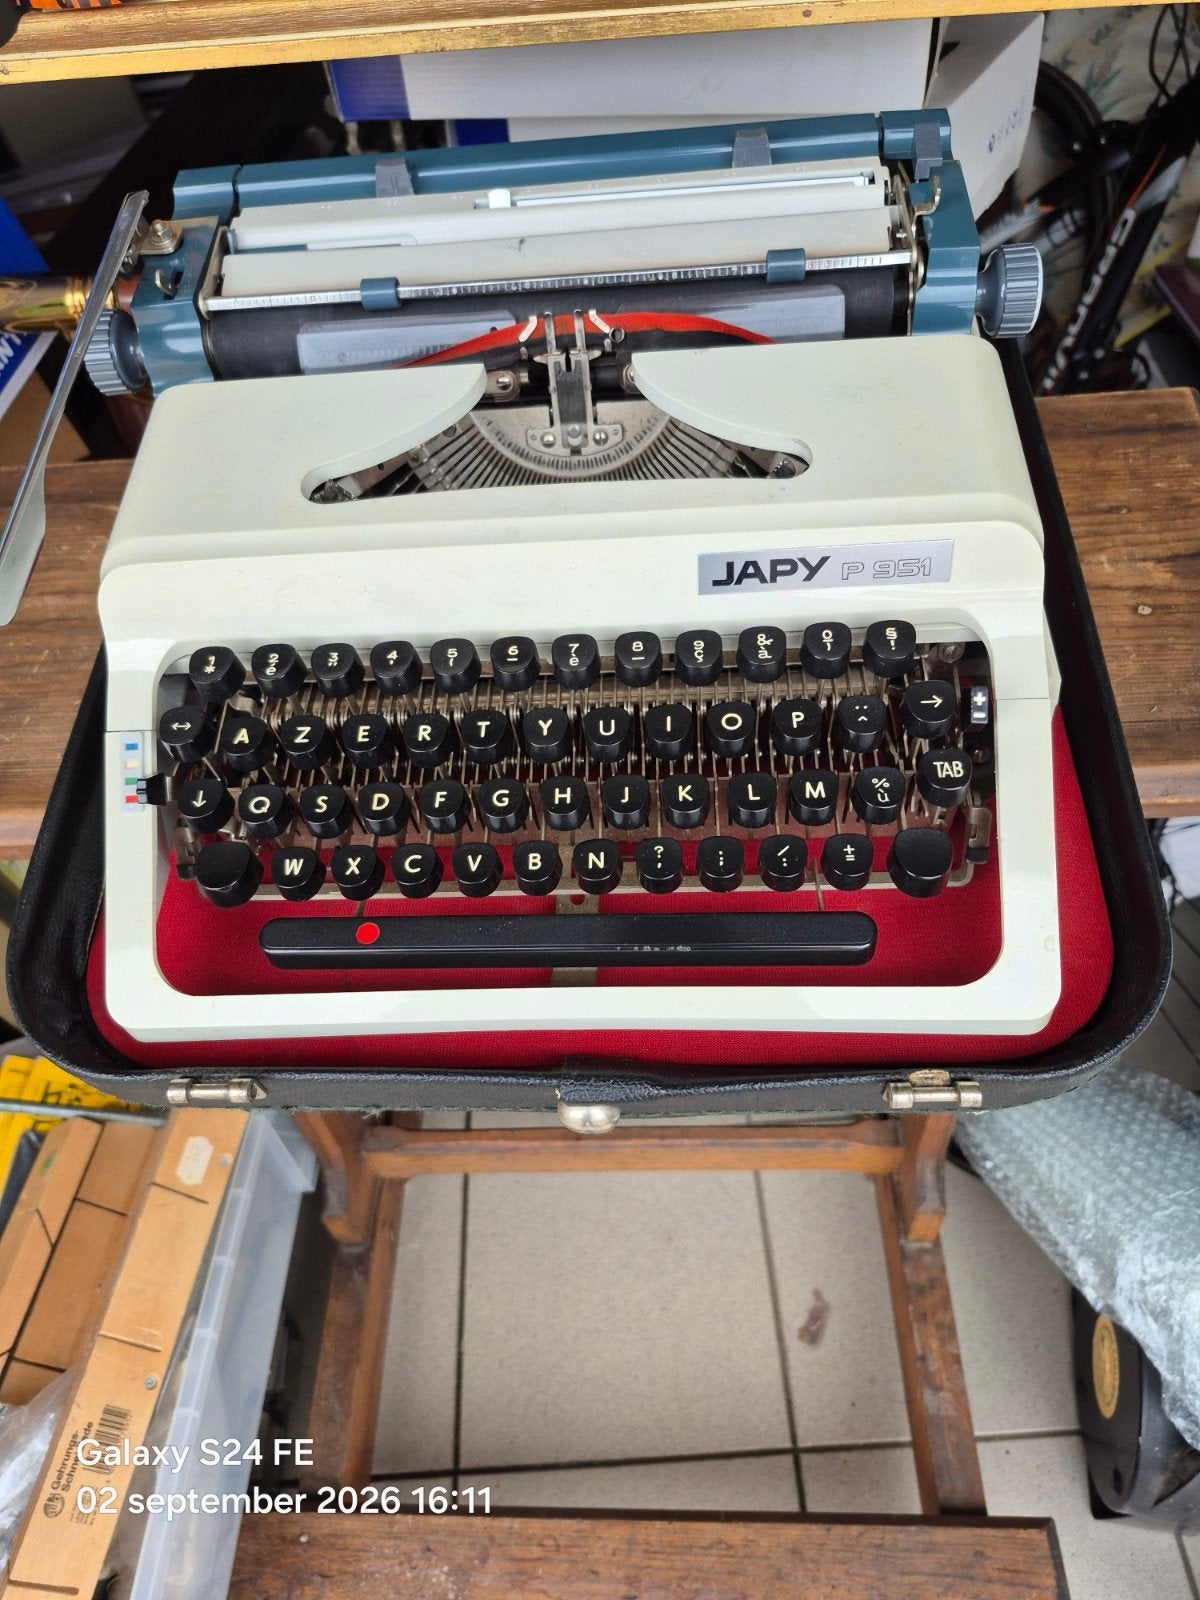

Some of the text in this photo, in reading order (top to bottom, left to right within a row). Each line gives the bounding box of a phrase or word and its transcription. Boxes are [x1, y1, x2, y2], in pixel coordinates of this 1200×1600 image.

[712, 556, 831, 587] JAPY
[841, 557, 932, 581] P 951
[568, 643, 580, 653] 7
[632, 641, 644, 652] 8
[693, 640, 705, 650] 9
[757, 633, 773, 646] &
[269, 653, 279, 663] 2
[329, 652, 339, 662] 3
[386, 650, 398, 661] 4
[447, 648, 458, 658] 5
[508, 646, 519, 655] 6
[207, 655, 216, 666] 1
[538, 719, 553, 736] Y
[599, 719, 615, 736] U
[666, 715, 672, 732] I
[721, 713, 743, 730] O
[791, 711, 805, 729] P
[233, 727, 250, 744] A
[294, 726, 311, 743] Z
[357, 725, 371, 742] E
[418, 725, 432, 742] R
[477, 721, 491, 738] T
[933, 760, 964, 778] TAB
[493, 789, 510, 807] G
[554, 787, 571, 804] H
[621, 786, 629, 803] J
[678, 784, 693, 802] K
[748, 783, 760, 800] L
[805, 781, 826, 799] M
[249, 796, 271, 814] Q
[314, 795, 329, 813] S
[371, 793, 390, 811] D
[434, 791, 447, 808] F
[284, 859, 304, 876] W
[345, 857, 362, 876] X
[404, 855, 423, 873] C
[467, 854, 482, 872] V
[528, 853, 542, 870] B
[588, 852, 605, 869] N
